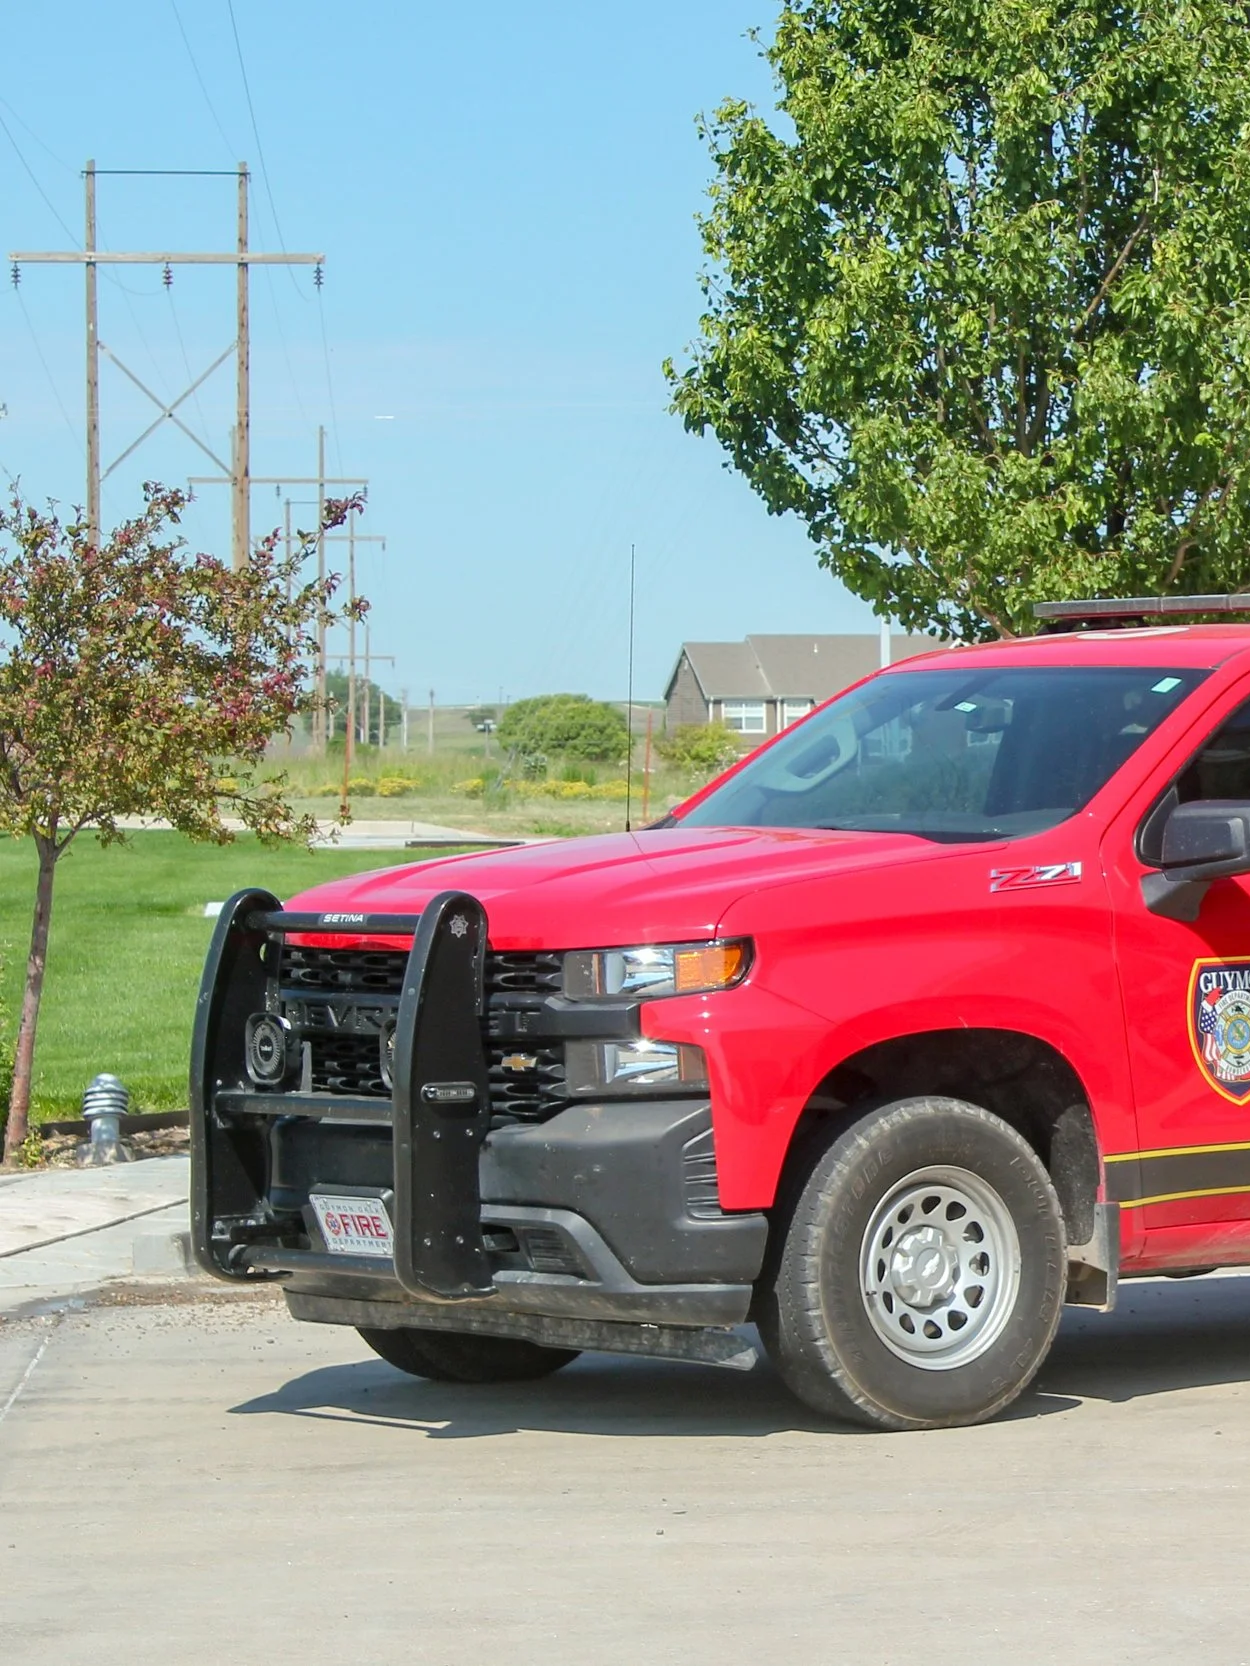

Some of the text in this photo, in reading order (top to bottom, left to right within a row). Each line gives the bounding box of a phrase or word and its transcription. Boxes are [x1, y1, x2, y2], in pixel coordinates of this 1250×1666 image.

[990, 861, 1082, 893] Z71
[323, 914, 364, 923] SETINA
[338, 1214, 388, 1238] FIRE
